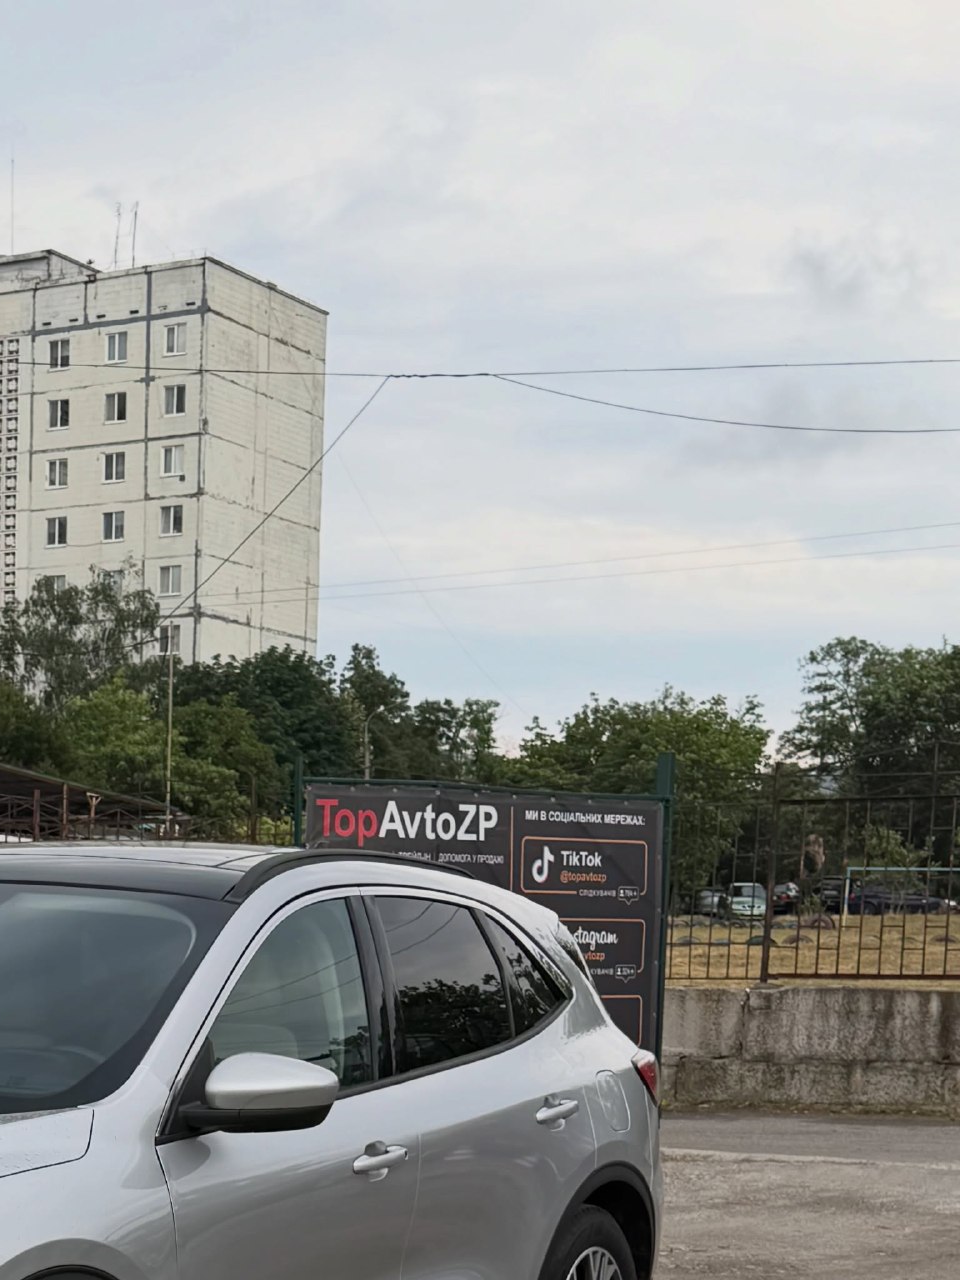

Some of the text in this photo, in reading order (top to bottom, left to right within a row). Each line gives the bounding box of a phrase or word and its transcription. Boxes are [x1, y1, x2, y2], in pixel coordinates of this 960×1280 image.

[315, 798, 499, 847] TopAvtoZP
[525, 810, 646, 825] МИ В СОЦІАЛЬНИХ МЕРЕЖАХ:
[438, 853, 471, 862] ДОПОМОГА
[472, 855, 477, 863] У
[560, 850, 602, 867] TikTok
[560, 870, 607, 883] @topavtozp
[573, 925, 619, 951] stagram
